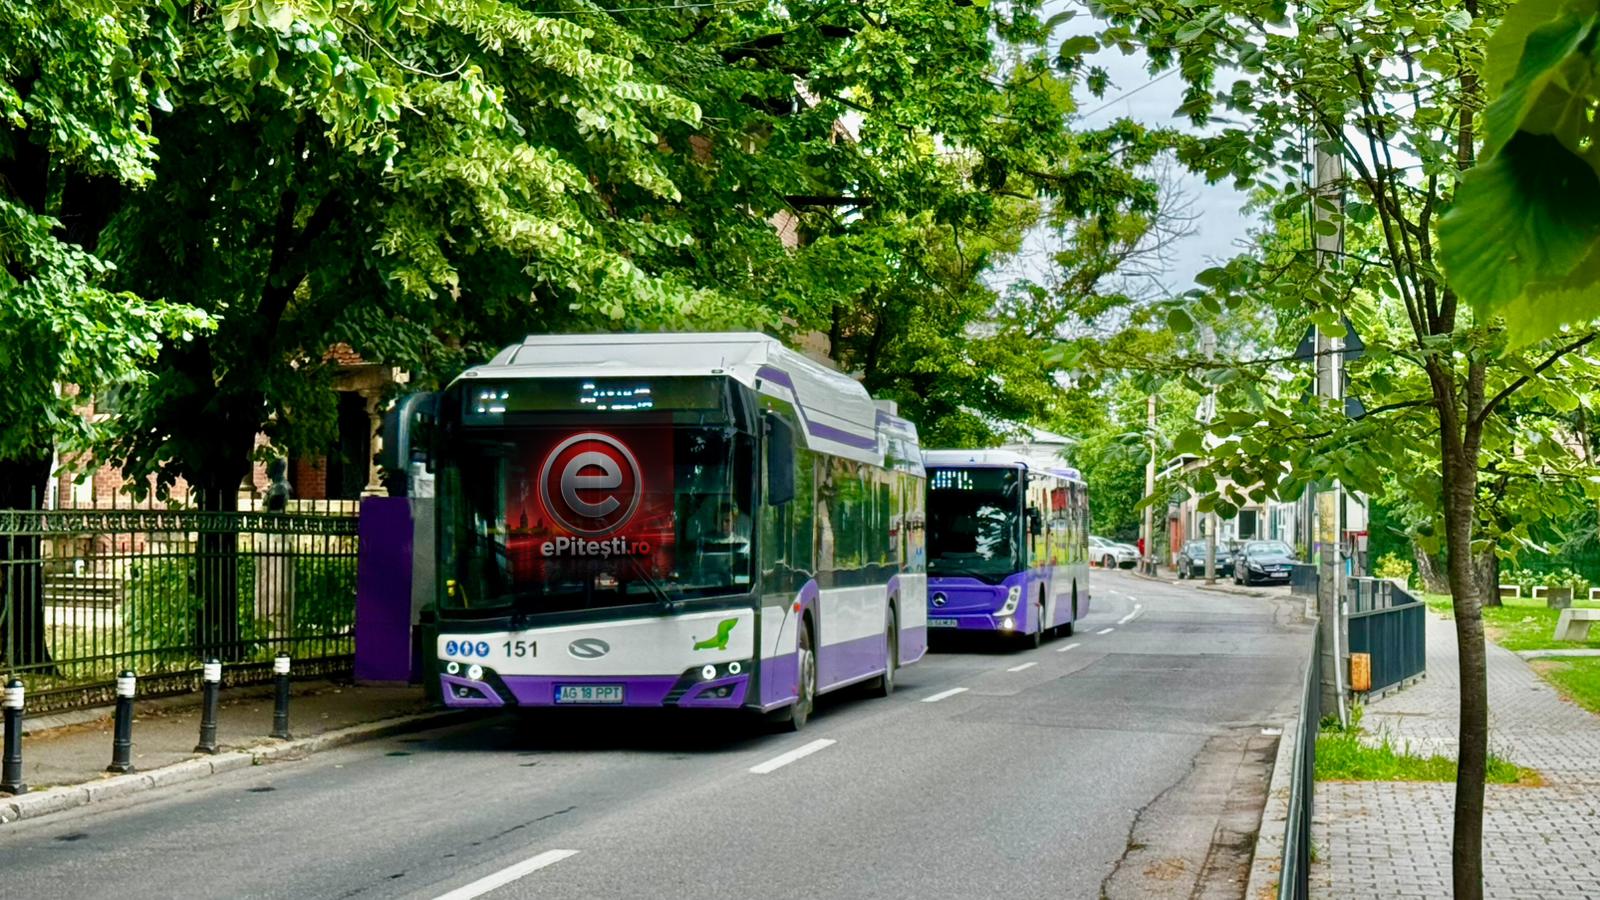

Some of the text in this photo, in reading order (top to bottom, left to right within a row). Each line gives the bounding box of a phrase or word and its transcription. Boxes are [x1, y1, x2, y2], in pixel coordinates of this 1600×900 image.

[503, 641, 537, 657] 151
[562, 687, 577, 699] AG
[596, 687, 620, 699] PPT
